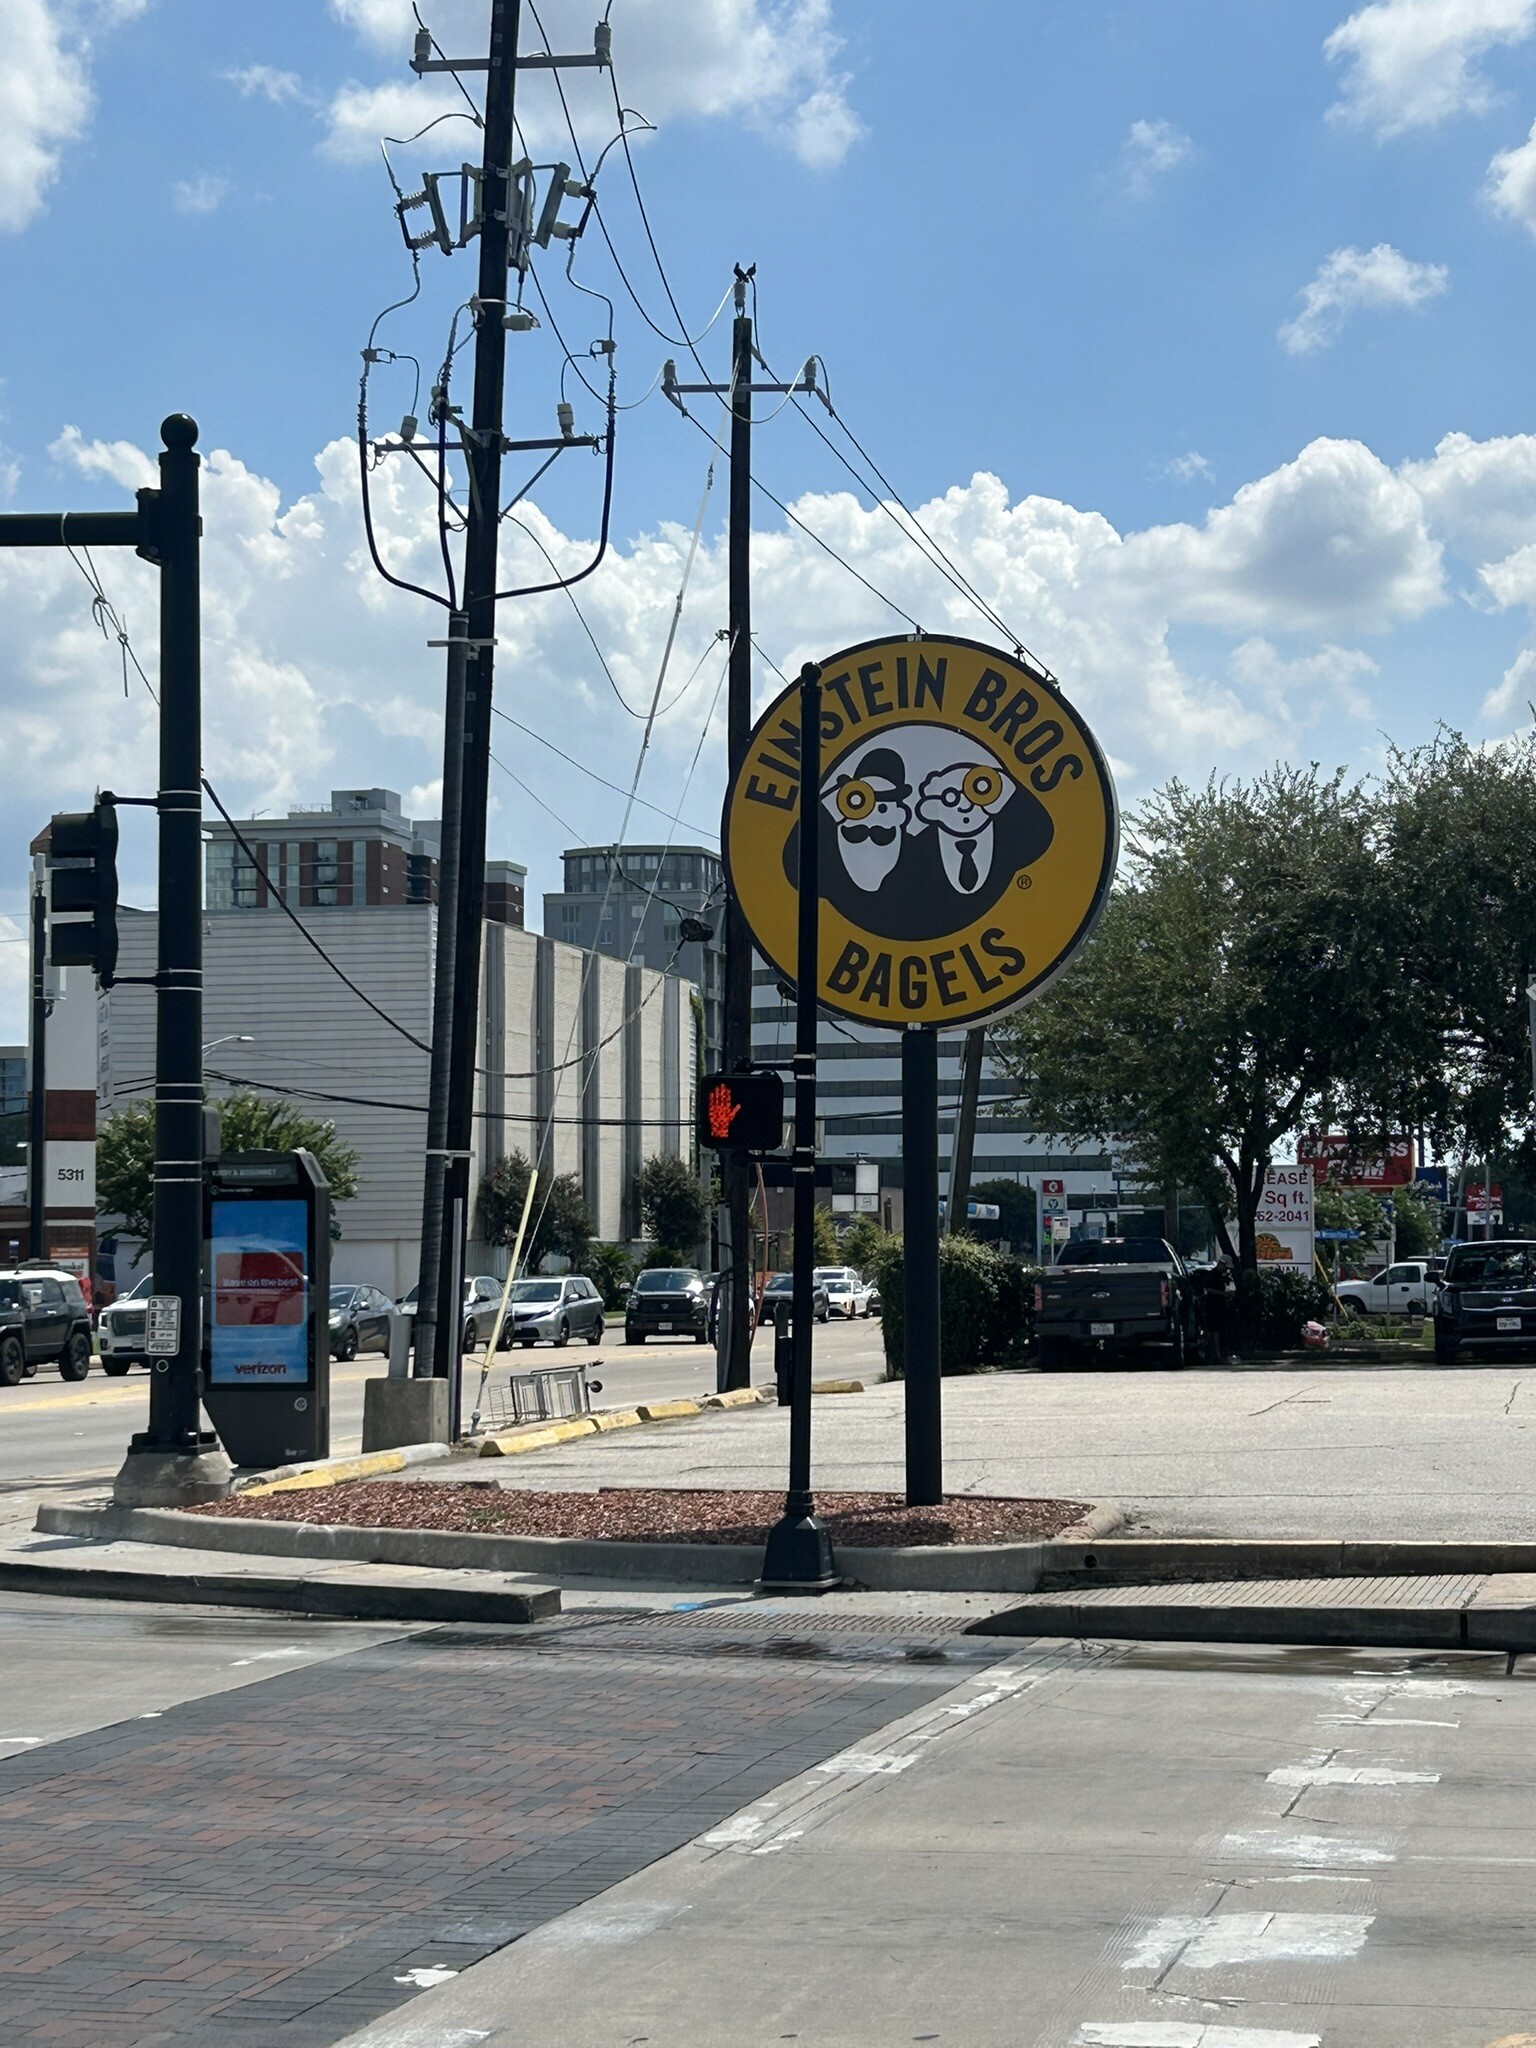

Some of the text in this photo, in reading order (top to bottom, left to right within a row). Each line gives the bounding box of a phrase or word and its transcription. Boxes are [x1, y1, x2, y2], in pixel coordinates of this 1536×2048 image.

[963, 667, 1083, 793] BROS
[826, 927, 1026, 1009] BAGELS
[57, 1168, 85, 1181] 5311
[1263, 1172, 1308, 1185] EASE
[1265, 1190, 1309, 1208] Sq ft.
[235, 1362, 287, 1375] verizon
